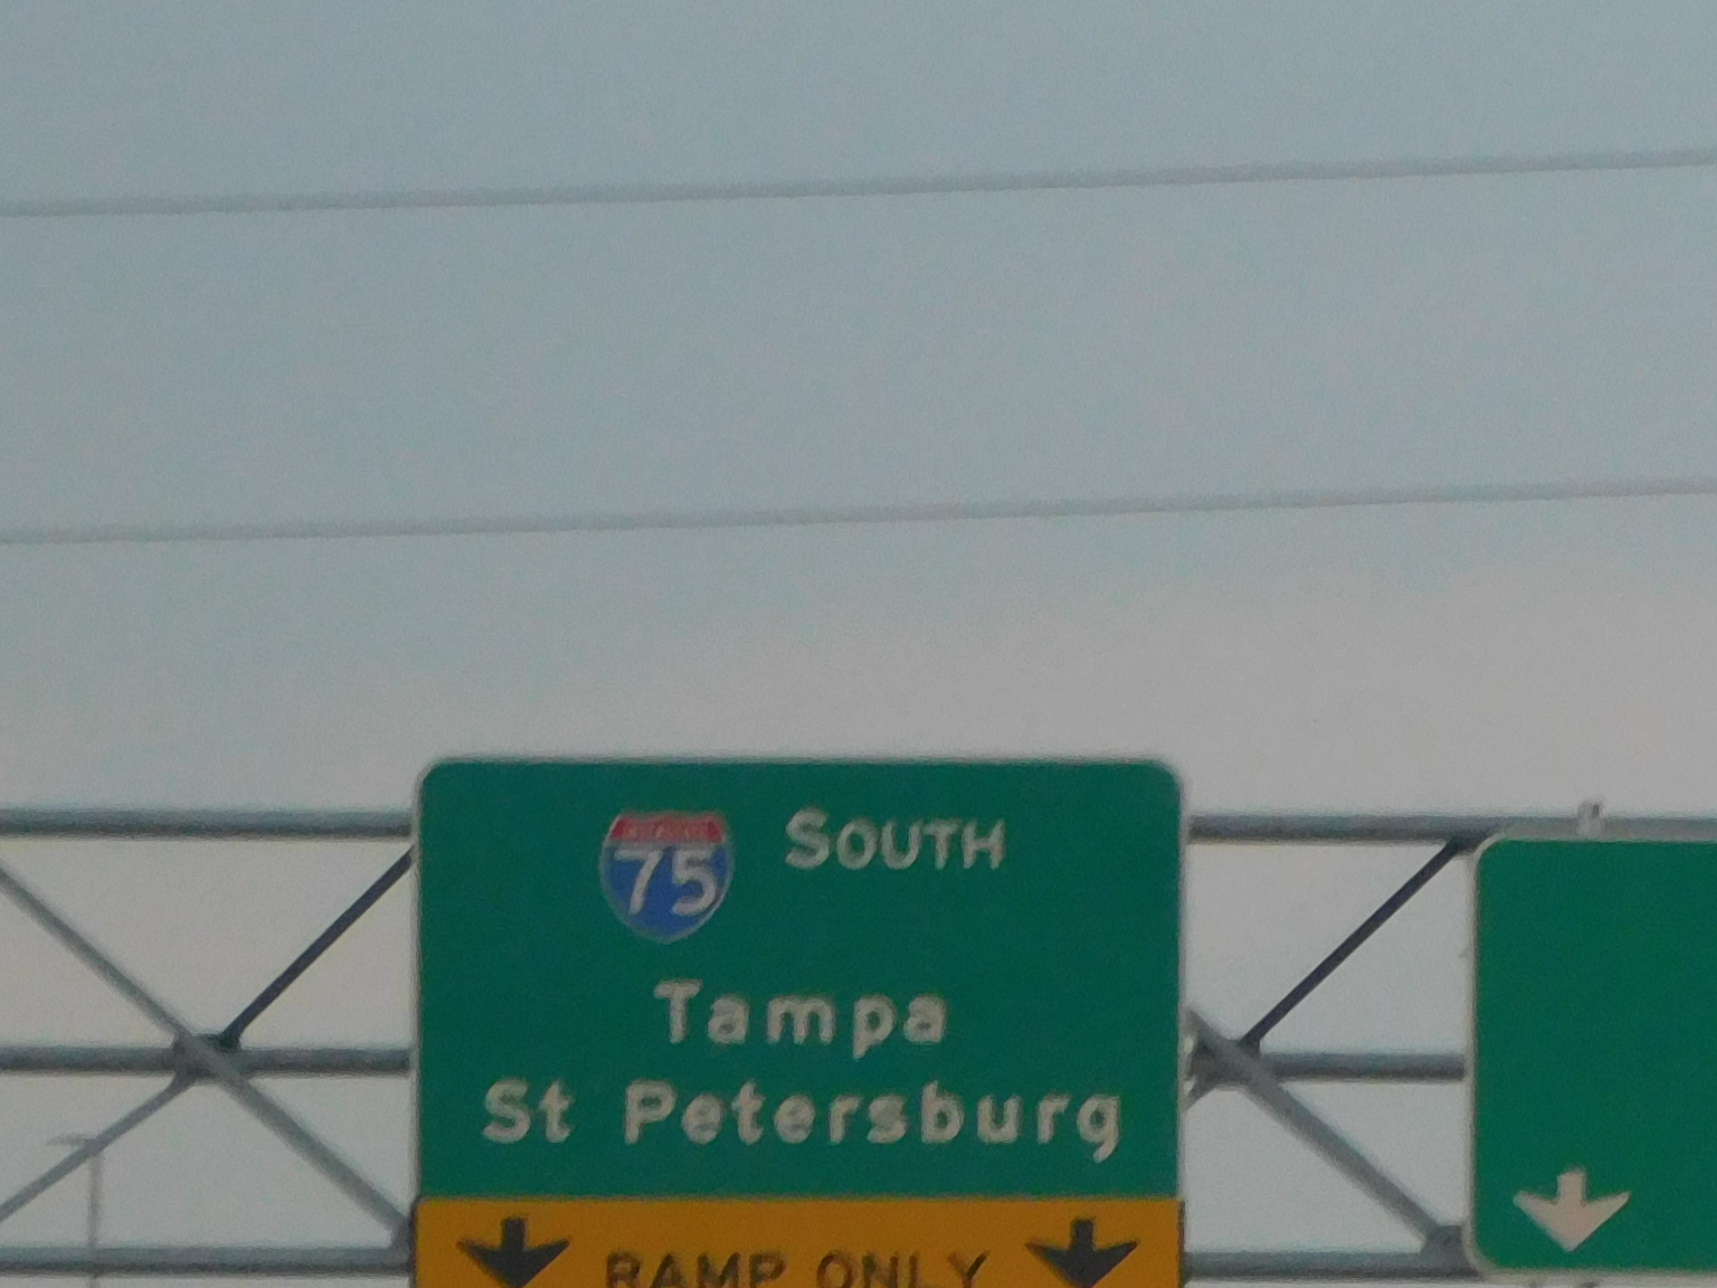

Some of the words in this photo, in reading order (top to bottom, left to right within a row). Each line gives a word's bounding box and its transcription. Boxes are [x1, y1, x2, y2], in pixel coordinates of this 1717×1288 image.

[784, 808, 1007, 870] SOUTH
[612, 847, 720, 916] 75
[653, 977, 950, 1060] Tampa
[481, 1076, 576, 1144] St
[623, 1079, 1123, 1162] Petersburg
